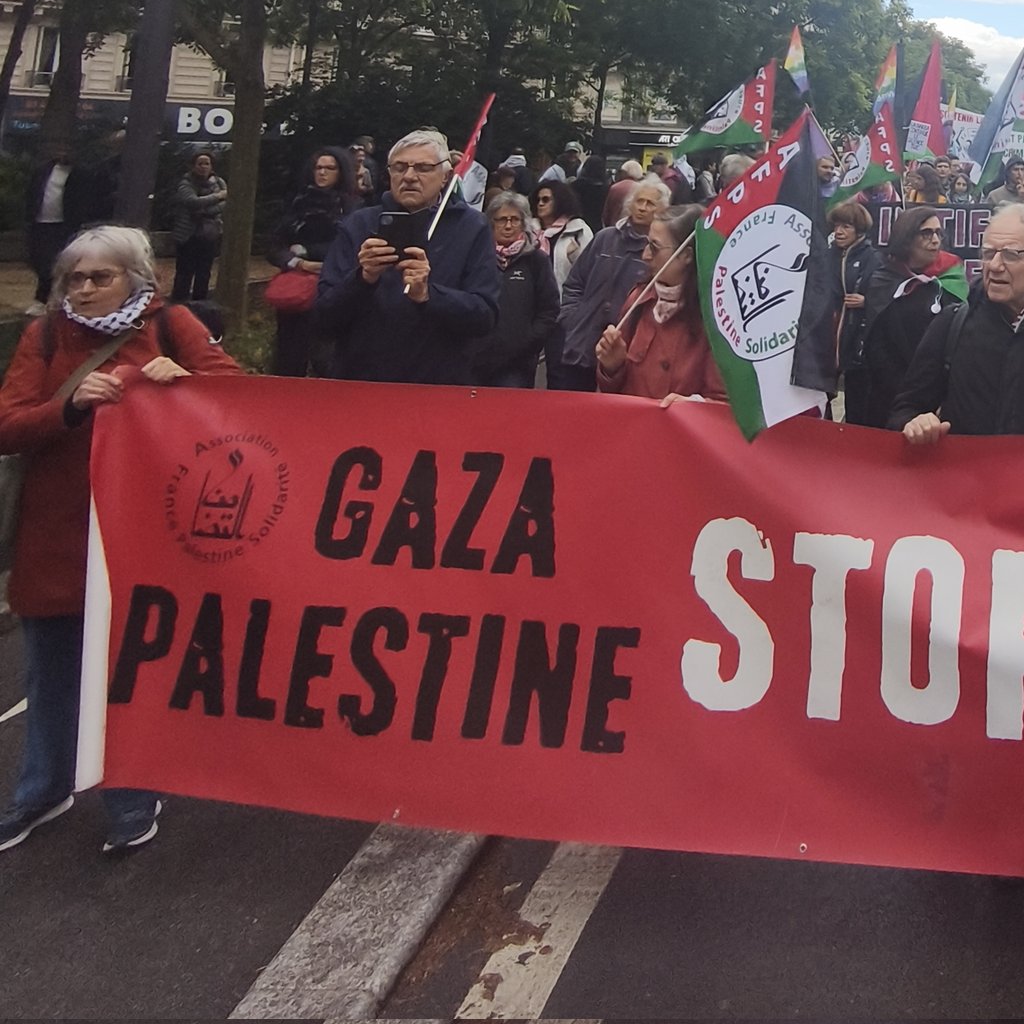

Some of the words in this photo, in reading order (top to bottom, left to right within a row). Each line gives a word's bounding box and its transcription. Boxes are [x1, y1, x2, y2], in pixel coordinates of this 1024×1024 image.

[177, 107, 234, 135] BO
[703, 141, 800, 230] AFPS
[729, 210, 776, 248] France
[714, 265, 741, 347] Palestine
[194, 434, 279, 457] Association
[315, 446, 556, 578] GAZA
[107, 584, 641, 753] PALESTINE
